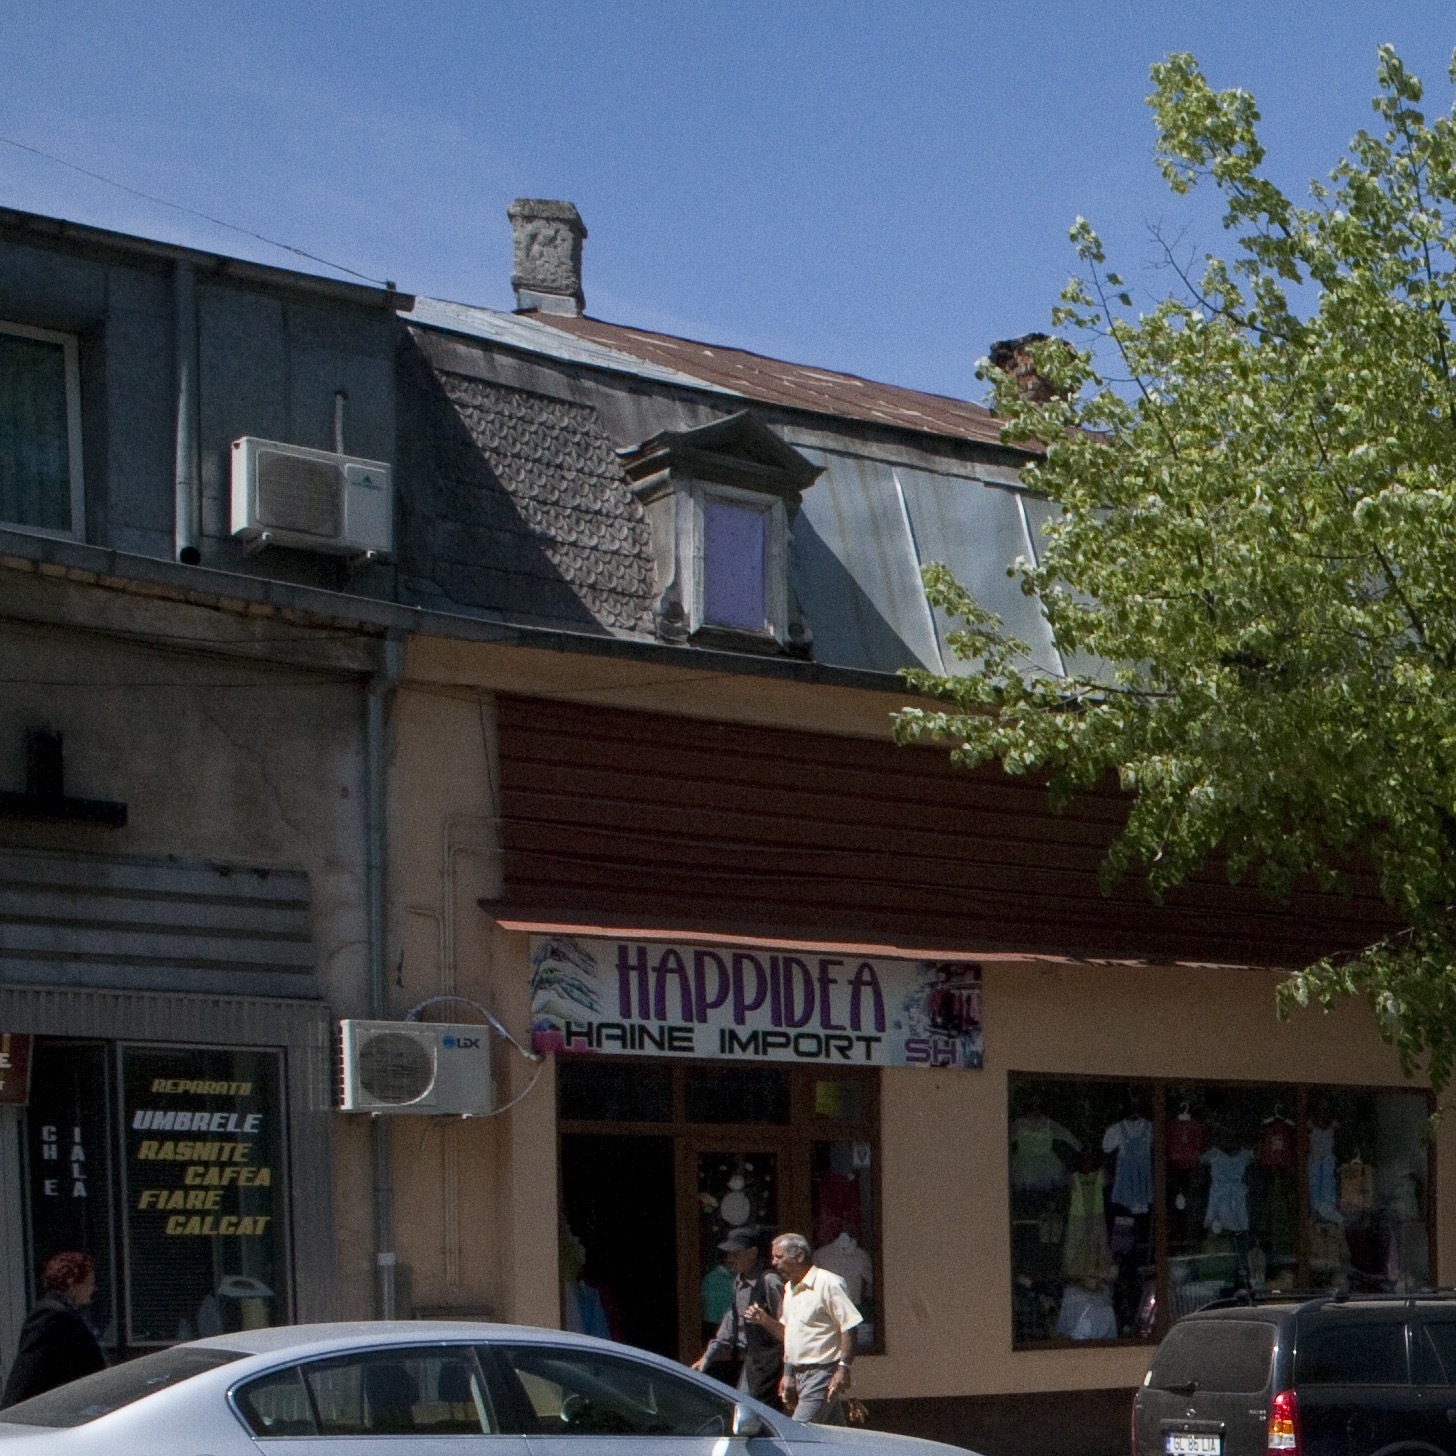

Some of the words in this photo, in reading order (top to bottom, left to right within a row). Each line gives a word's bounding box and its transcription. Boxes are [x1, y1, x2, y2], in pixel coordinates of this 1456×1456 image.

[616, 943, 887, 1034] HAPPIDEA
[563, 1020, 696, 1053] HAINE
[719, 1026, 883, 1062] IMPORT
[903, 1037, 959, 1067] SH
[132, 1109, 264, 1133] UMBRELE
[137, 1140, 253, 1163] RASNITE
[184, 1165, 272, 1187] CAFEA
[137, 1189, 225, 1210] FIARE
[164, 1214, 272, 1236] CALCAT
